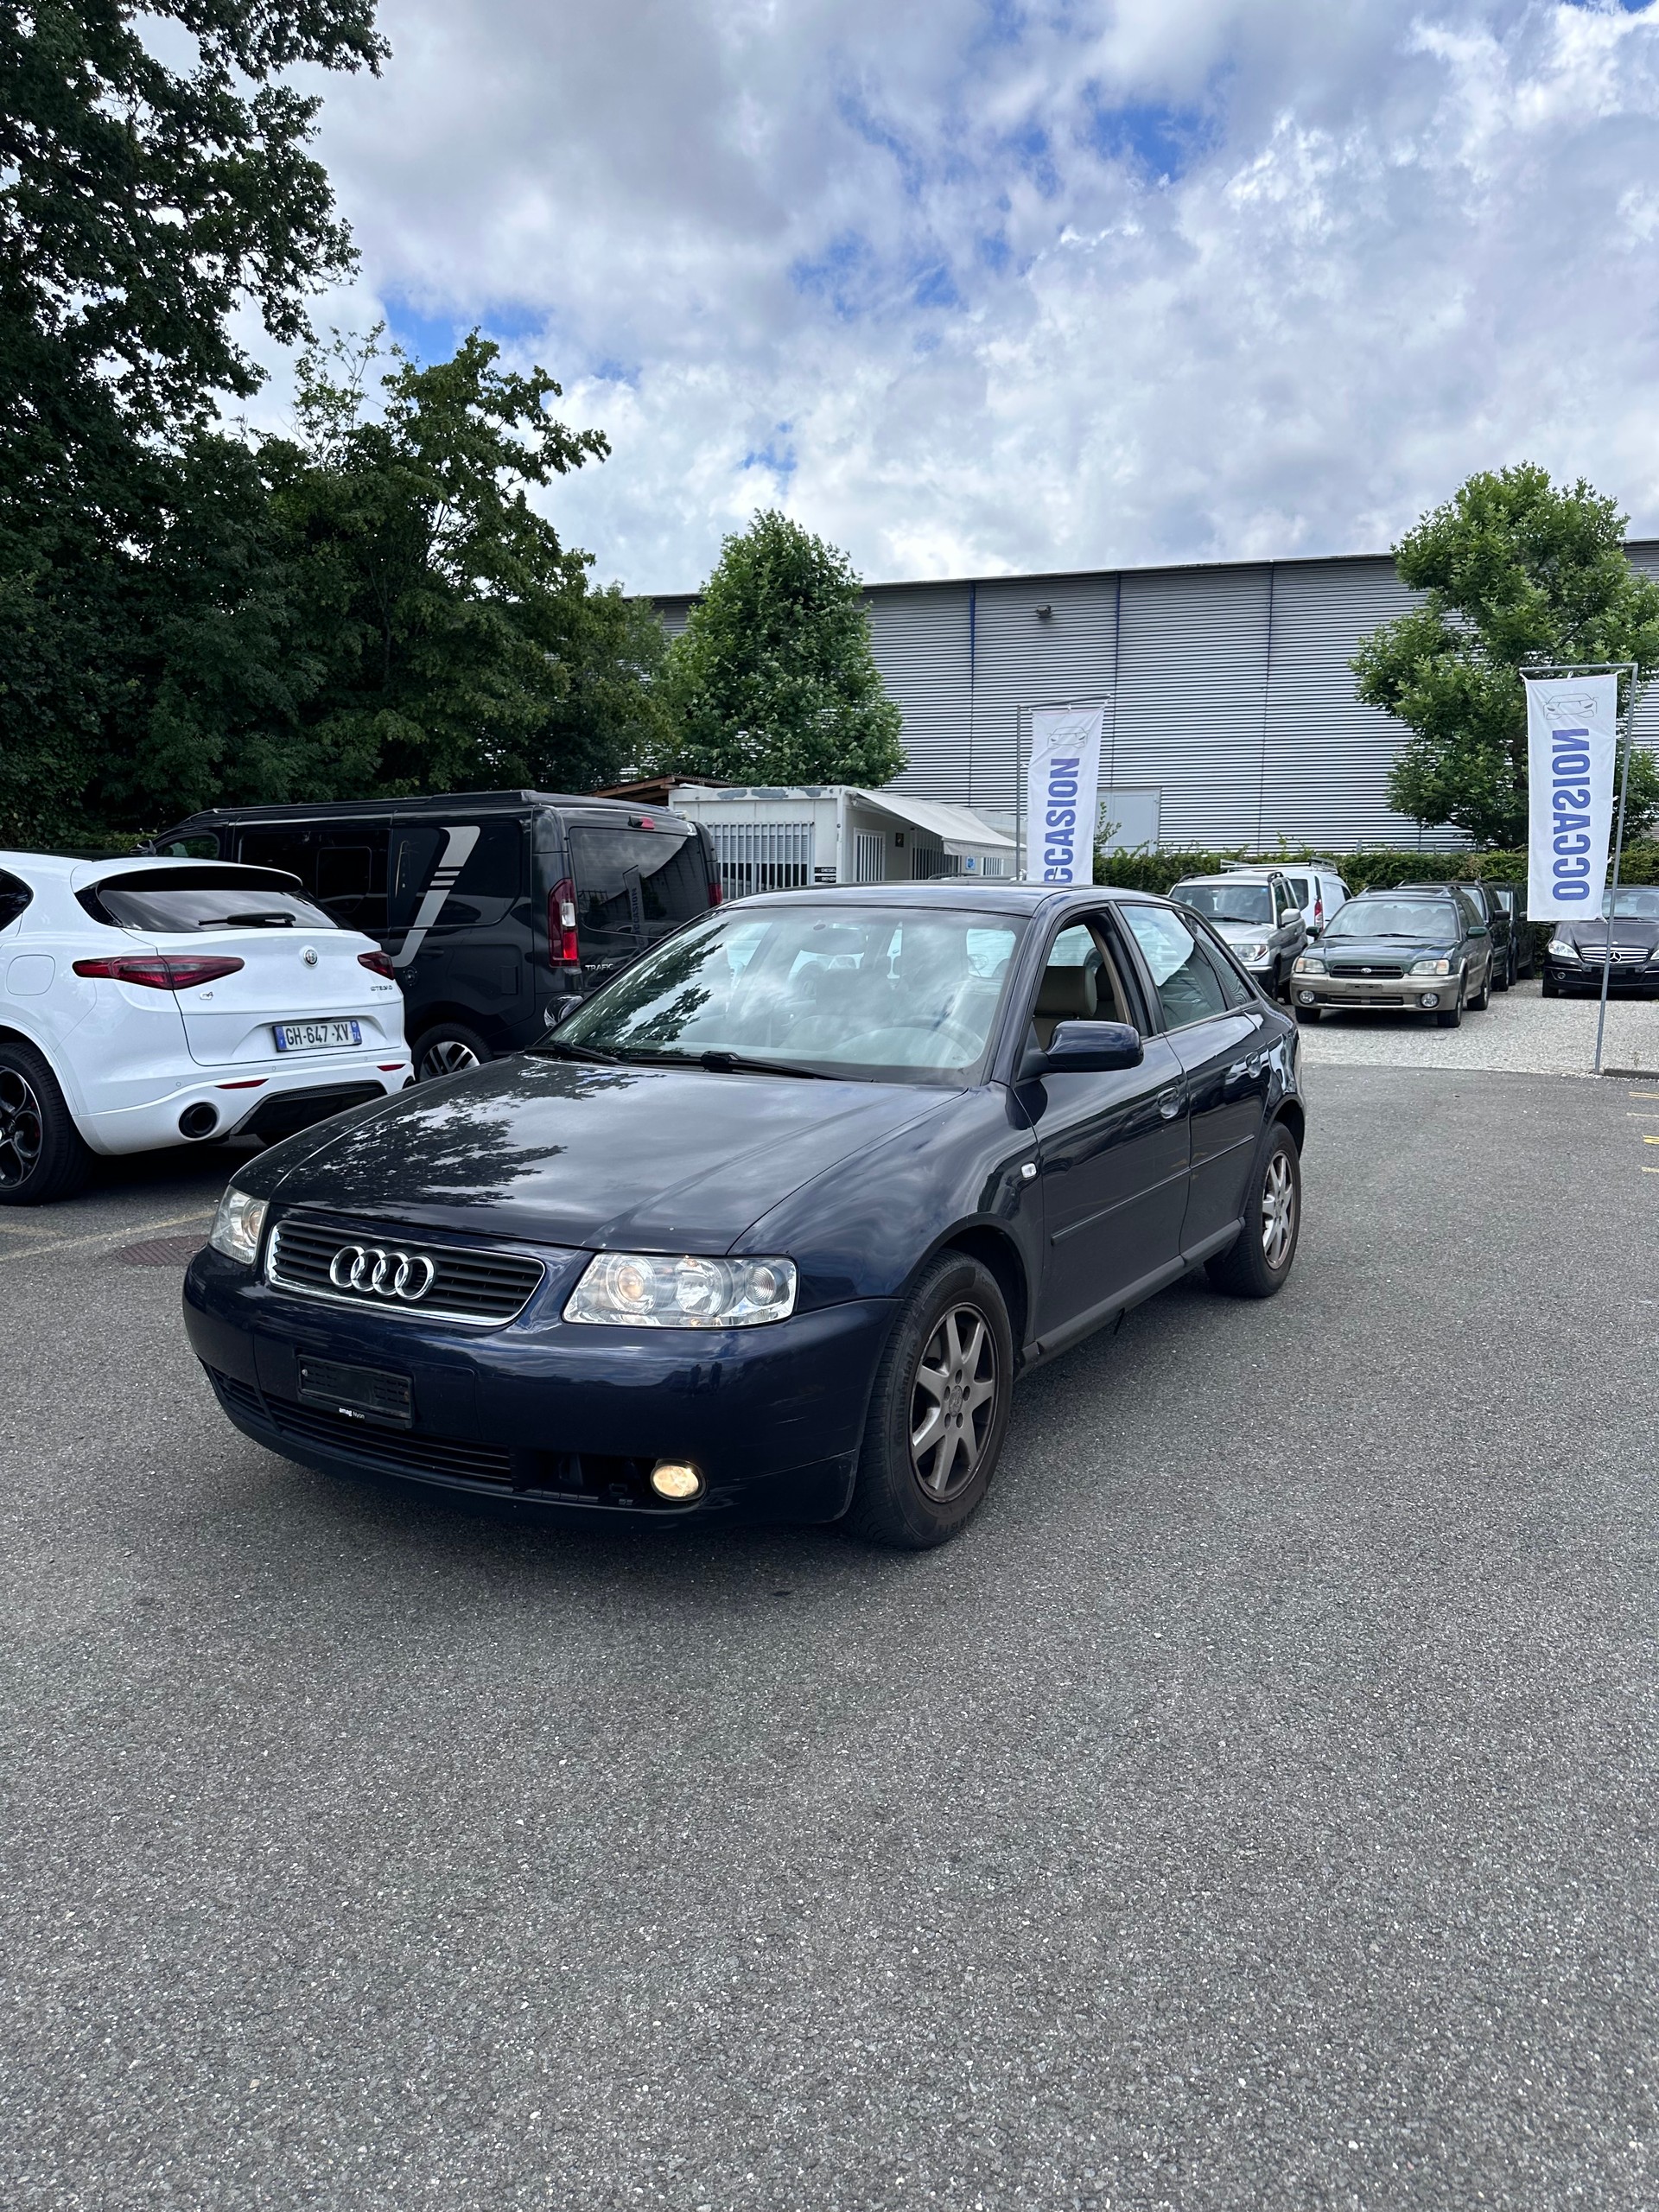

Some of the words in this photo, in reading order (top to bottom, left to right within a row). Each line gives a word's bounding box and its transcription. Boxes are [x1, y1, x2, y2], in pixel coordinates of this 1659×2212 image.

[1044, 758, 1080, 883] CCASION
[285, 1023, 349, 1046] GH-647-XV
[353, 1032, 361, 1040] 74
[339, 1408, 352, 1416] amag
